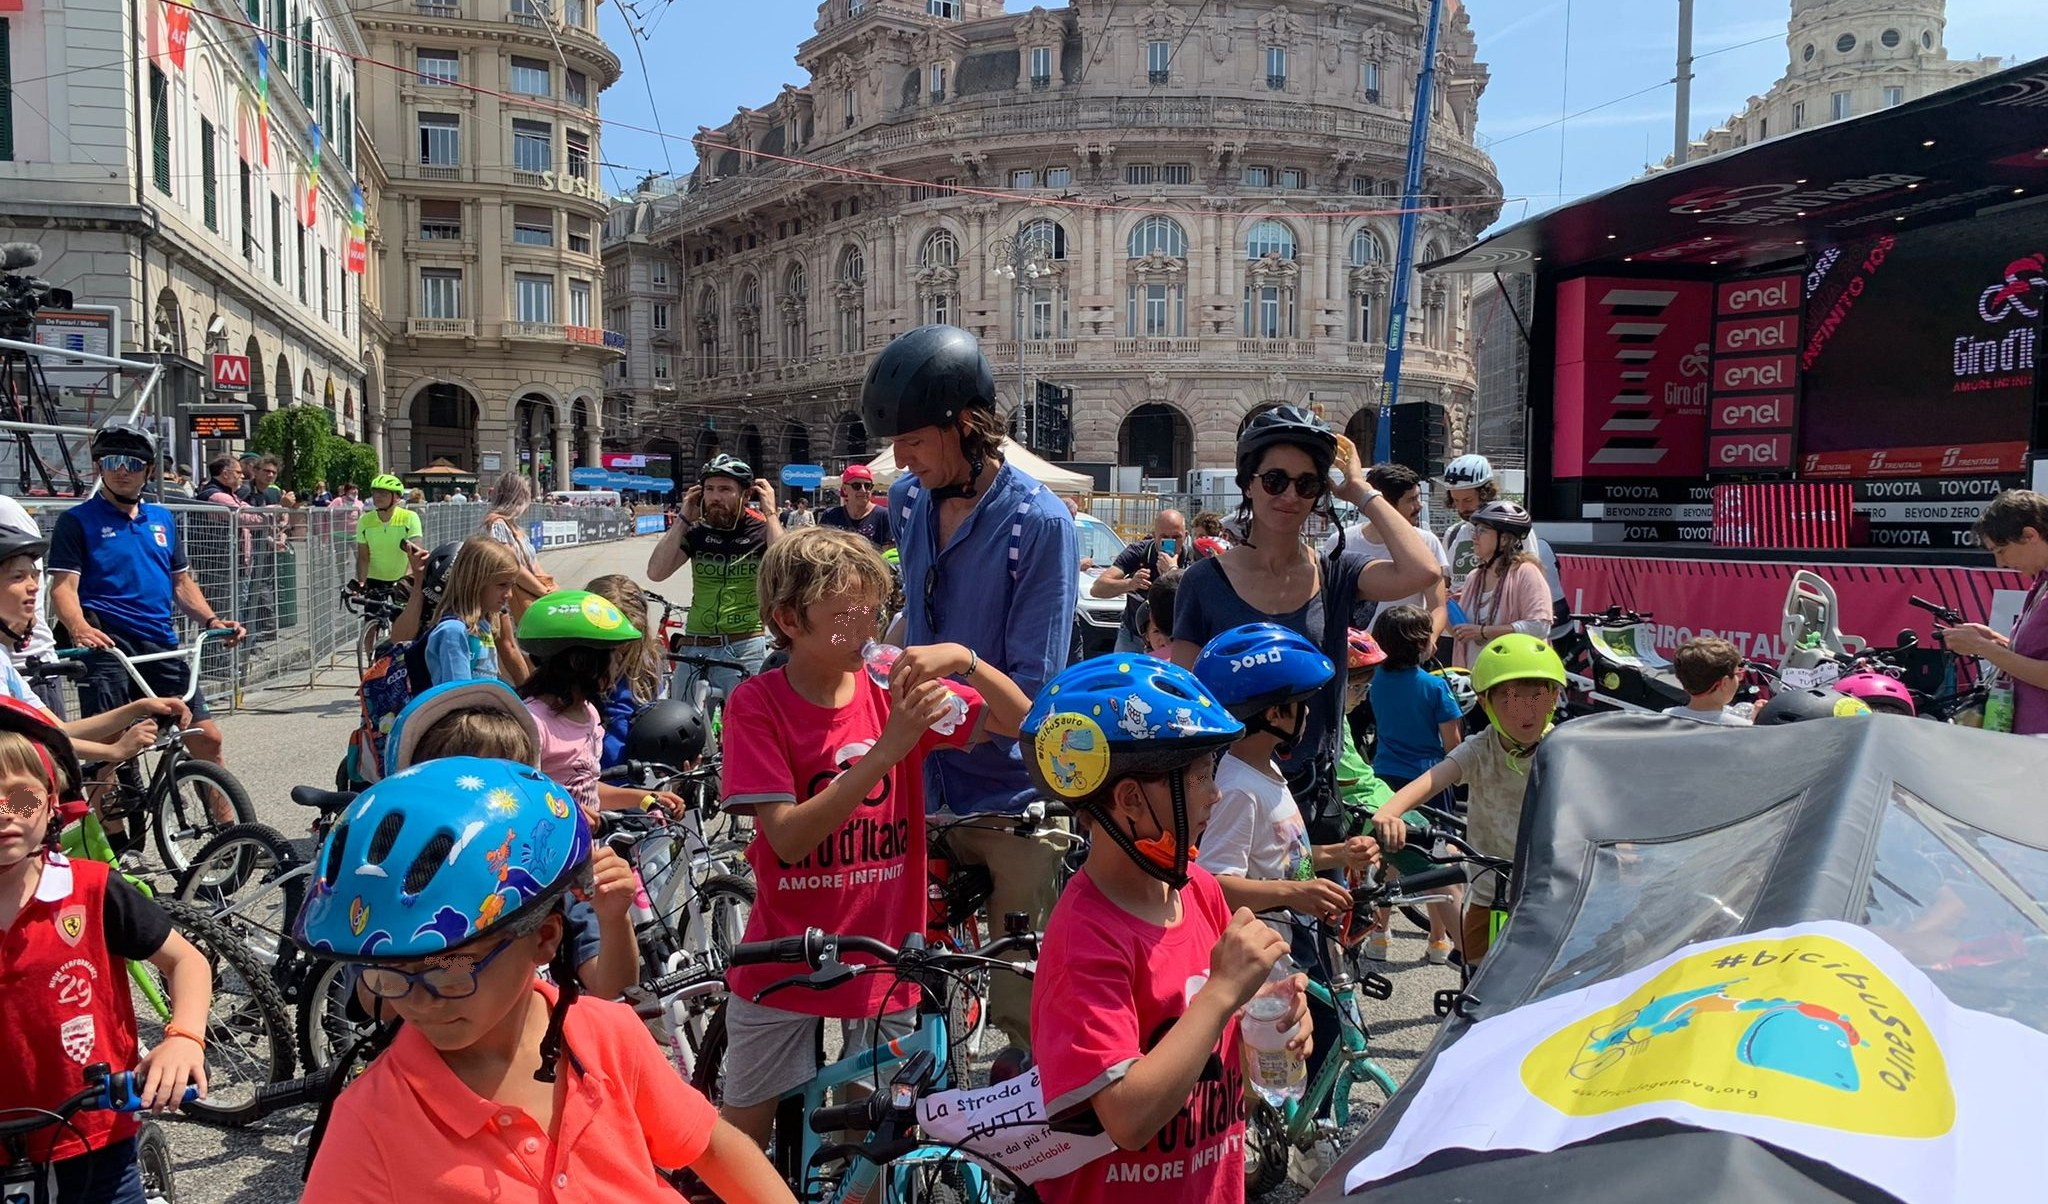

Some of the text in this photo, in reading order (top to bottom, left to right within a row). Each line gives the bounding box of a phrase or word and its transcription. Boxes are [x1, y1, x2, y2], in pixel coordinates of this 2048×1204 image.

[1806, 248, 1841, 299] ORE
[1729, 281, 1787, 309] enel
[1727, 320, 1785, 348] enel
[1953, 327, 2036, 376] Giro d'It
[218, 359, 247, 382] M
[1724, 360, 1782, 387] enel
[1993, 376, 2032, 388] INFINI
[1664, 381, 1691, 405] Giro
[1723, 399, 1780, 425] enel
[1720, 438, 1778, 463] enel
[1958, 458, 1999, 466] TRENITALIA
[1606, 486, 1659, 498] TOYOTA
[1866, 480, 2001, 496] TOYOTA TOYOTA
[1606, 507, 1713, 518] BEYOND ZERO BEYOND
[1905, 508, 1948, 518] BEYOND
[1950, 507, 1980, 518] ZERO
[1624, 527, 1712, 539] YOTA TOYOT
[1872, 530, 1930, 545] TOYOTA
[695, 551, 726, 563] ECO
[695, 563, 758, 576] COURIER
[726, 613, 751, 625] EBC
[778, 864, 904, 891] AMORE INFINIT
[48, 958, 98, 989] HIGH PERFORMANCE
[57, 974, 93, 1008] 29
[670, 1035, 689, 1077] OLMO
[925, 1102, 948, 1122] La
[1030, 1072, 1040, 1088] è
[966, 1101, 1038, 1142] TUTTI
[1005, 1142, 1021, 1157] dal
[1023, 1133, 1040, 1150] più
[1105, 1134, 1242, 1184] AMORE INFINIT
